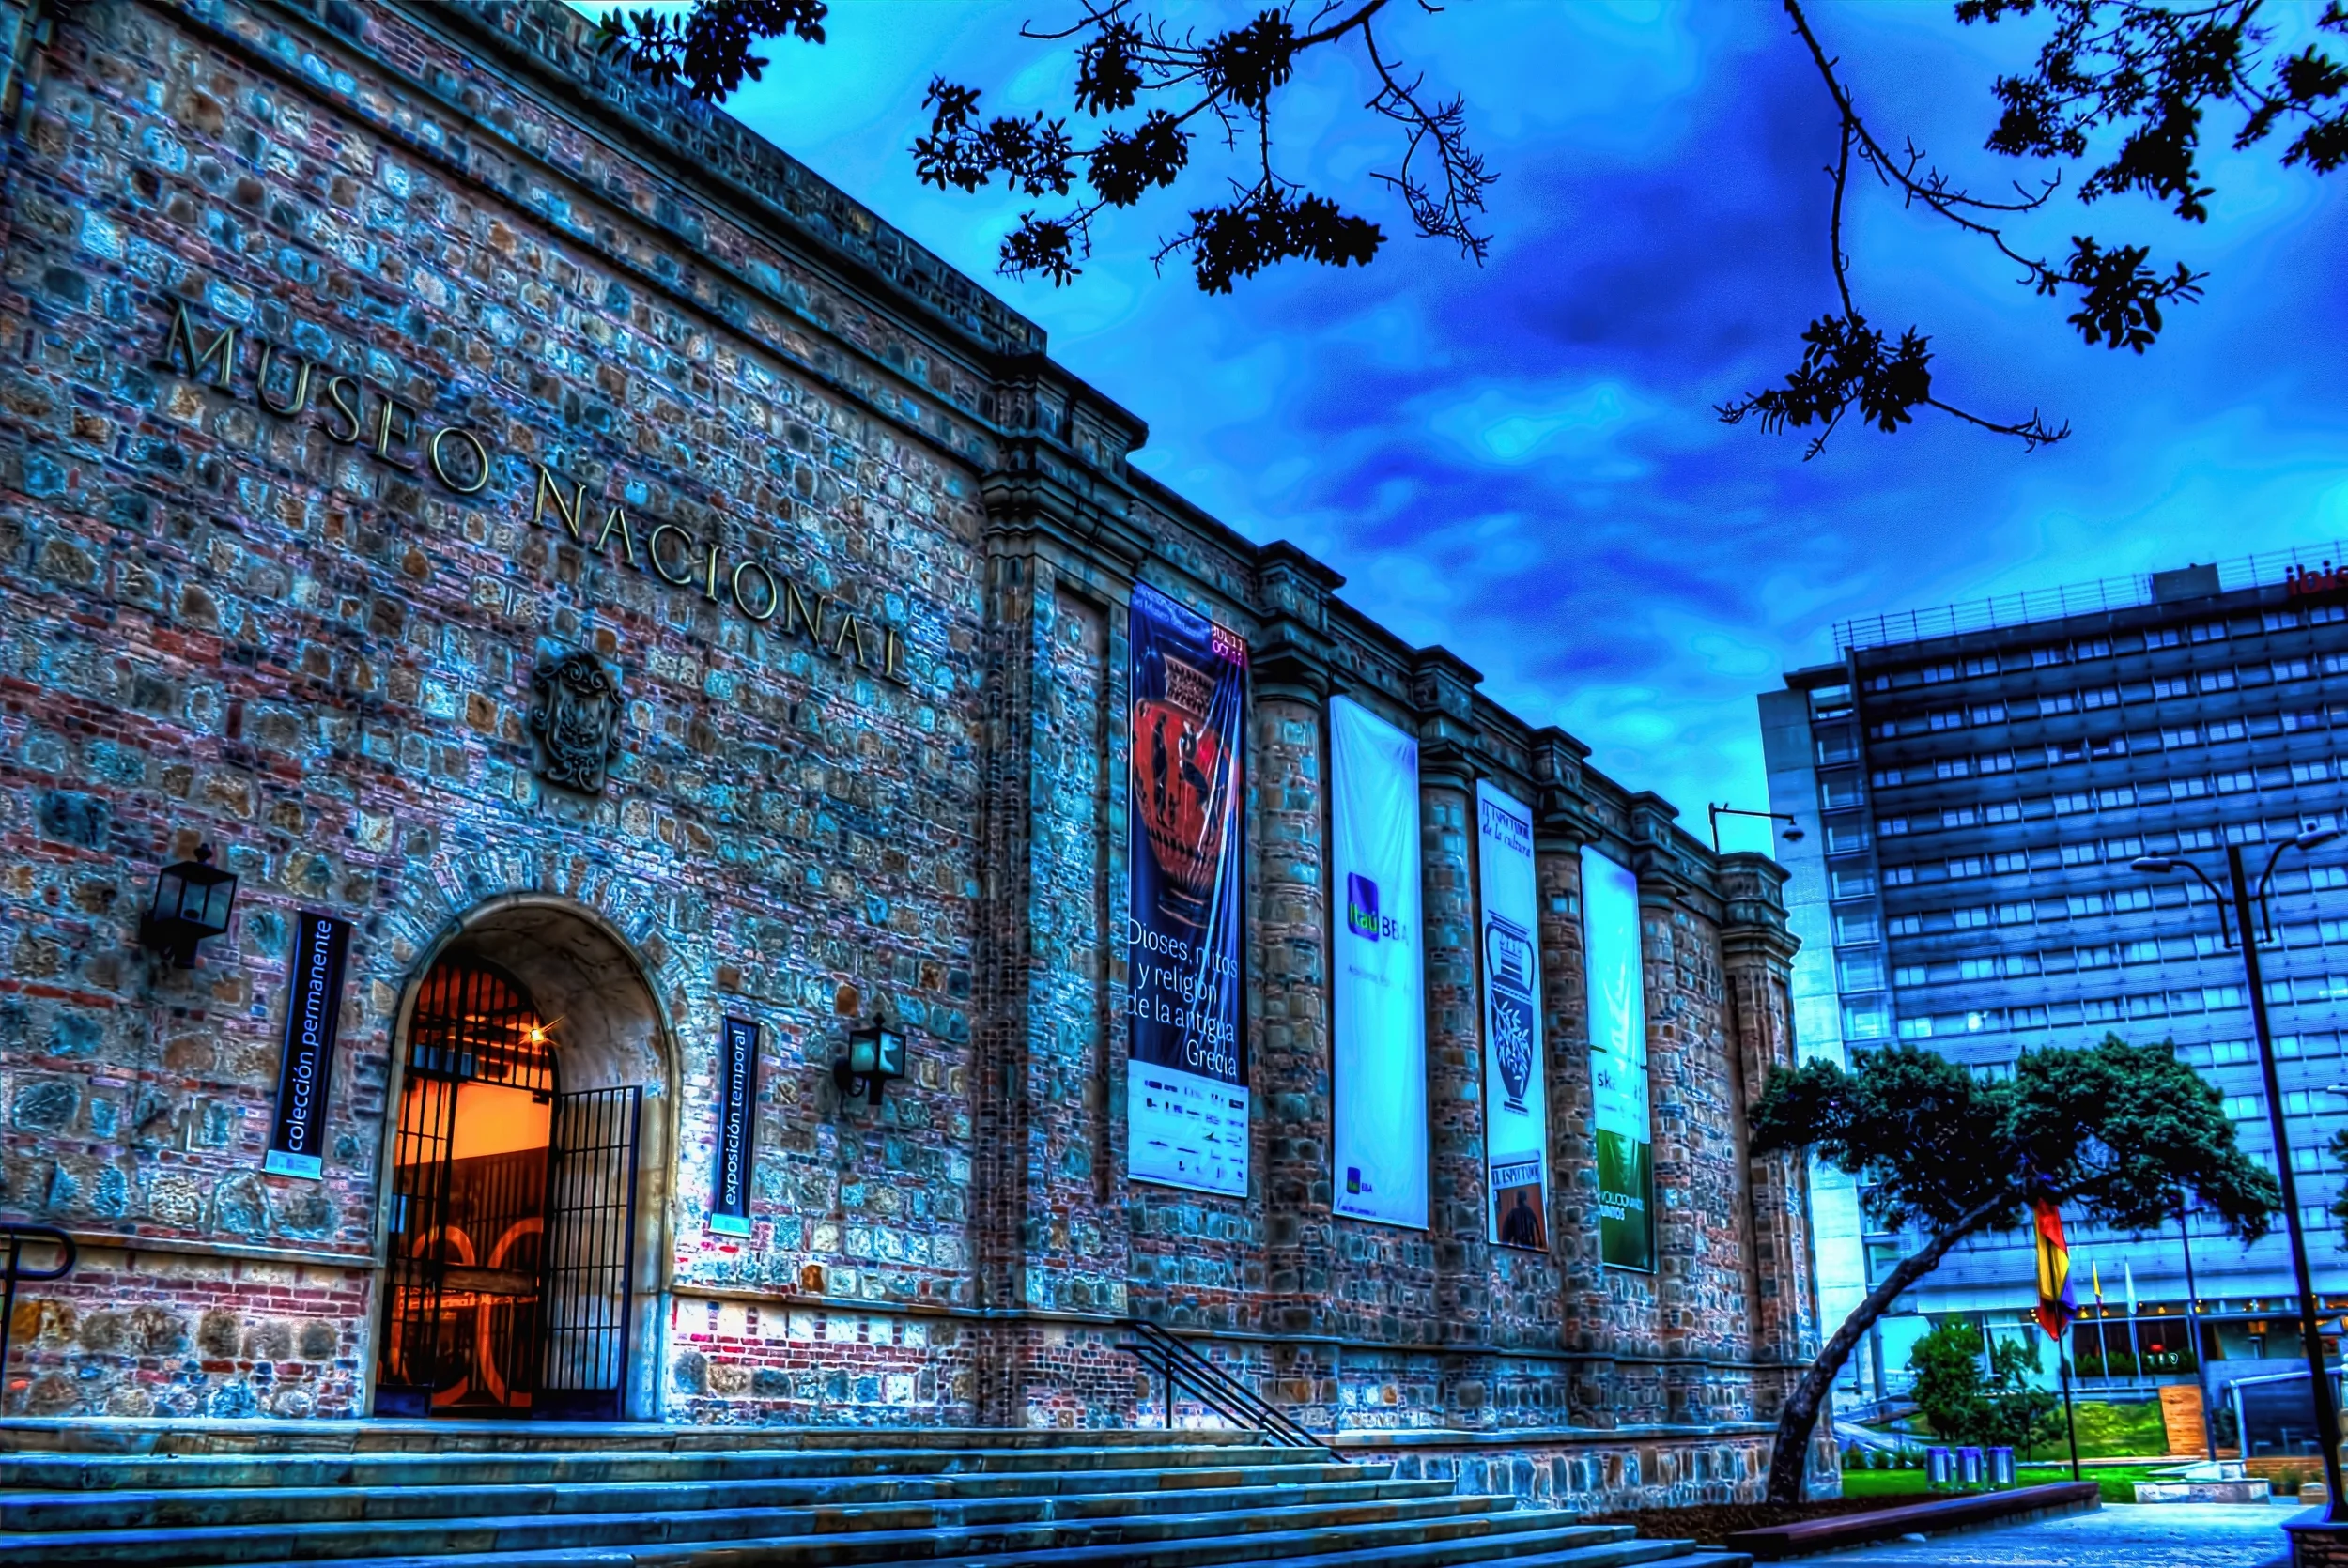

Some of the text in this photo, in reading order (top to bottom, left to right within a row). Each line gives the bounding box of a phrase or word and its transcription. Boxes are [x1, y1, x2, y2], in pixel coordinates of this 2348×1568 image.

[152, 295, 912, 688] MUSEO NACIONAL
[2285, 560, 2348, 595] ibis
[1127, 916, 1238, 978] Dioses, mitos
[1349, 901, 1409, 947] Itaú BBA
[1137, 962, 1150, 990] y
[286, 1051, 314, 1152] colección
[301, 919, 332, 1047] permanente
[1126, 989, 1235, 1044] de la antigua
[1186, 1038, 1237, 1076] Grecia
[725, 1029, 747, 1206] exposición temporal
